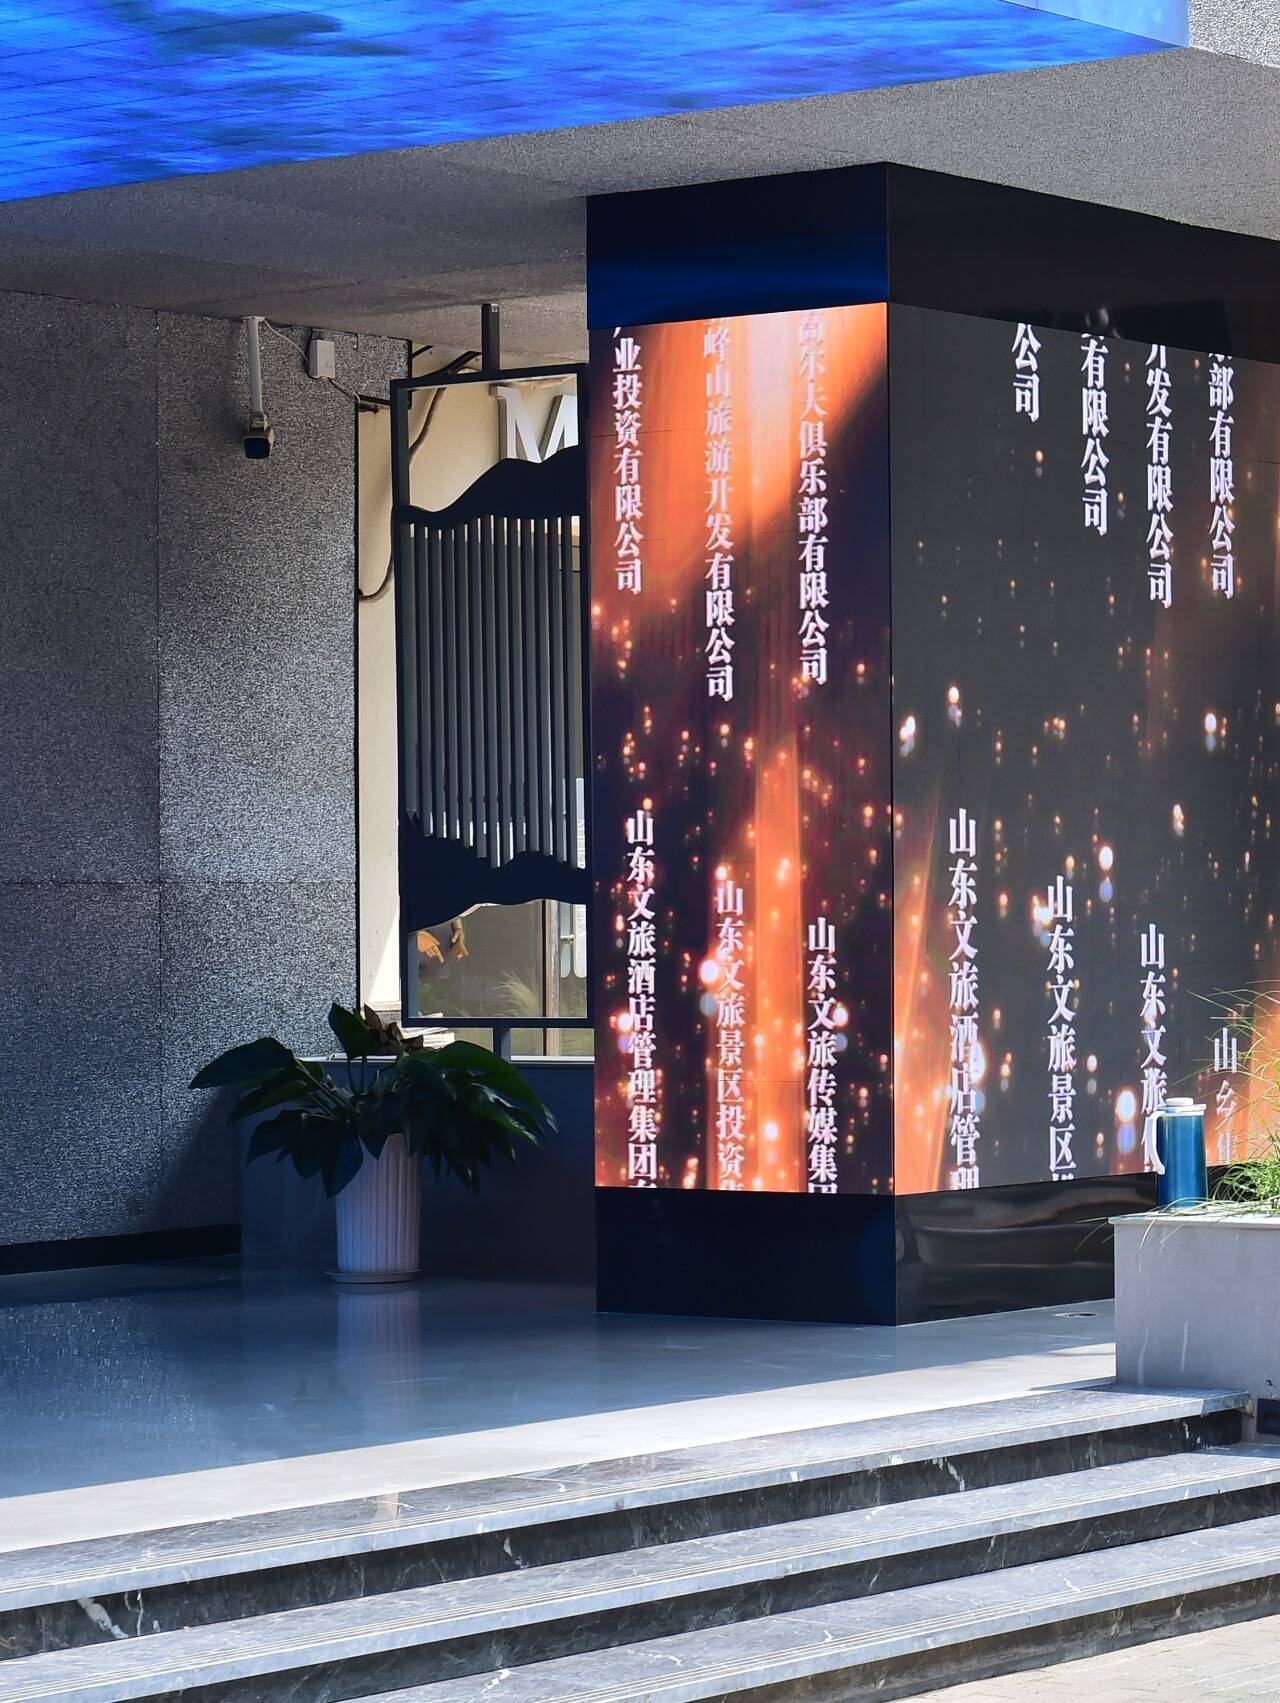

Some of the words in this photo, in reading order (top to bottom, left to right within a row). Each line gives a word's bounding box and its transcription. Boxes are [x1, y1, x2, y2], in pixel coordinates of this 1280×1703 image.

[612, 327, 643, 594] 业投资有限公司
[1012, 322, 1042, 422] 公司
[1081, 334, 1110, 536] 有限公司
[1208, 352, 1235, 599] 部有限公司
[704, 319, 735, 701] 峰山旅游开发有限公司
[627, 810, 657, 1188] 山东文旅酒店管理集团
[1047, 875, 1077, 1180] 山东文旅景区
